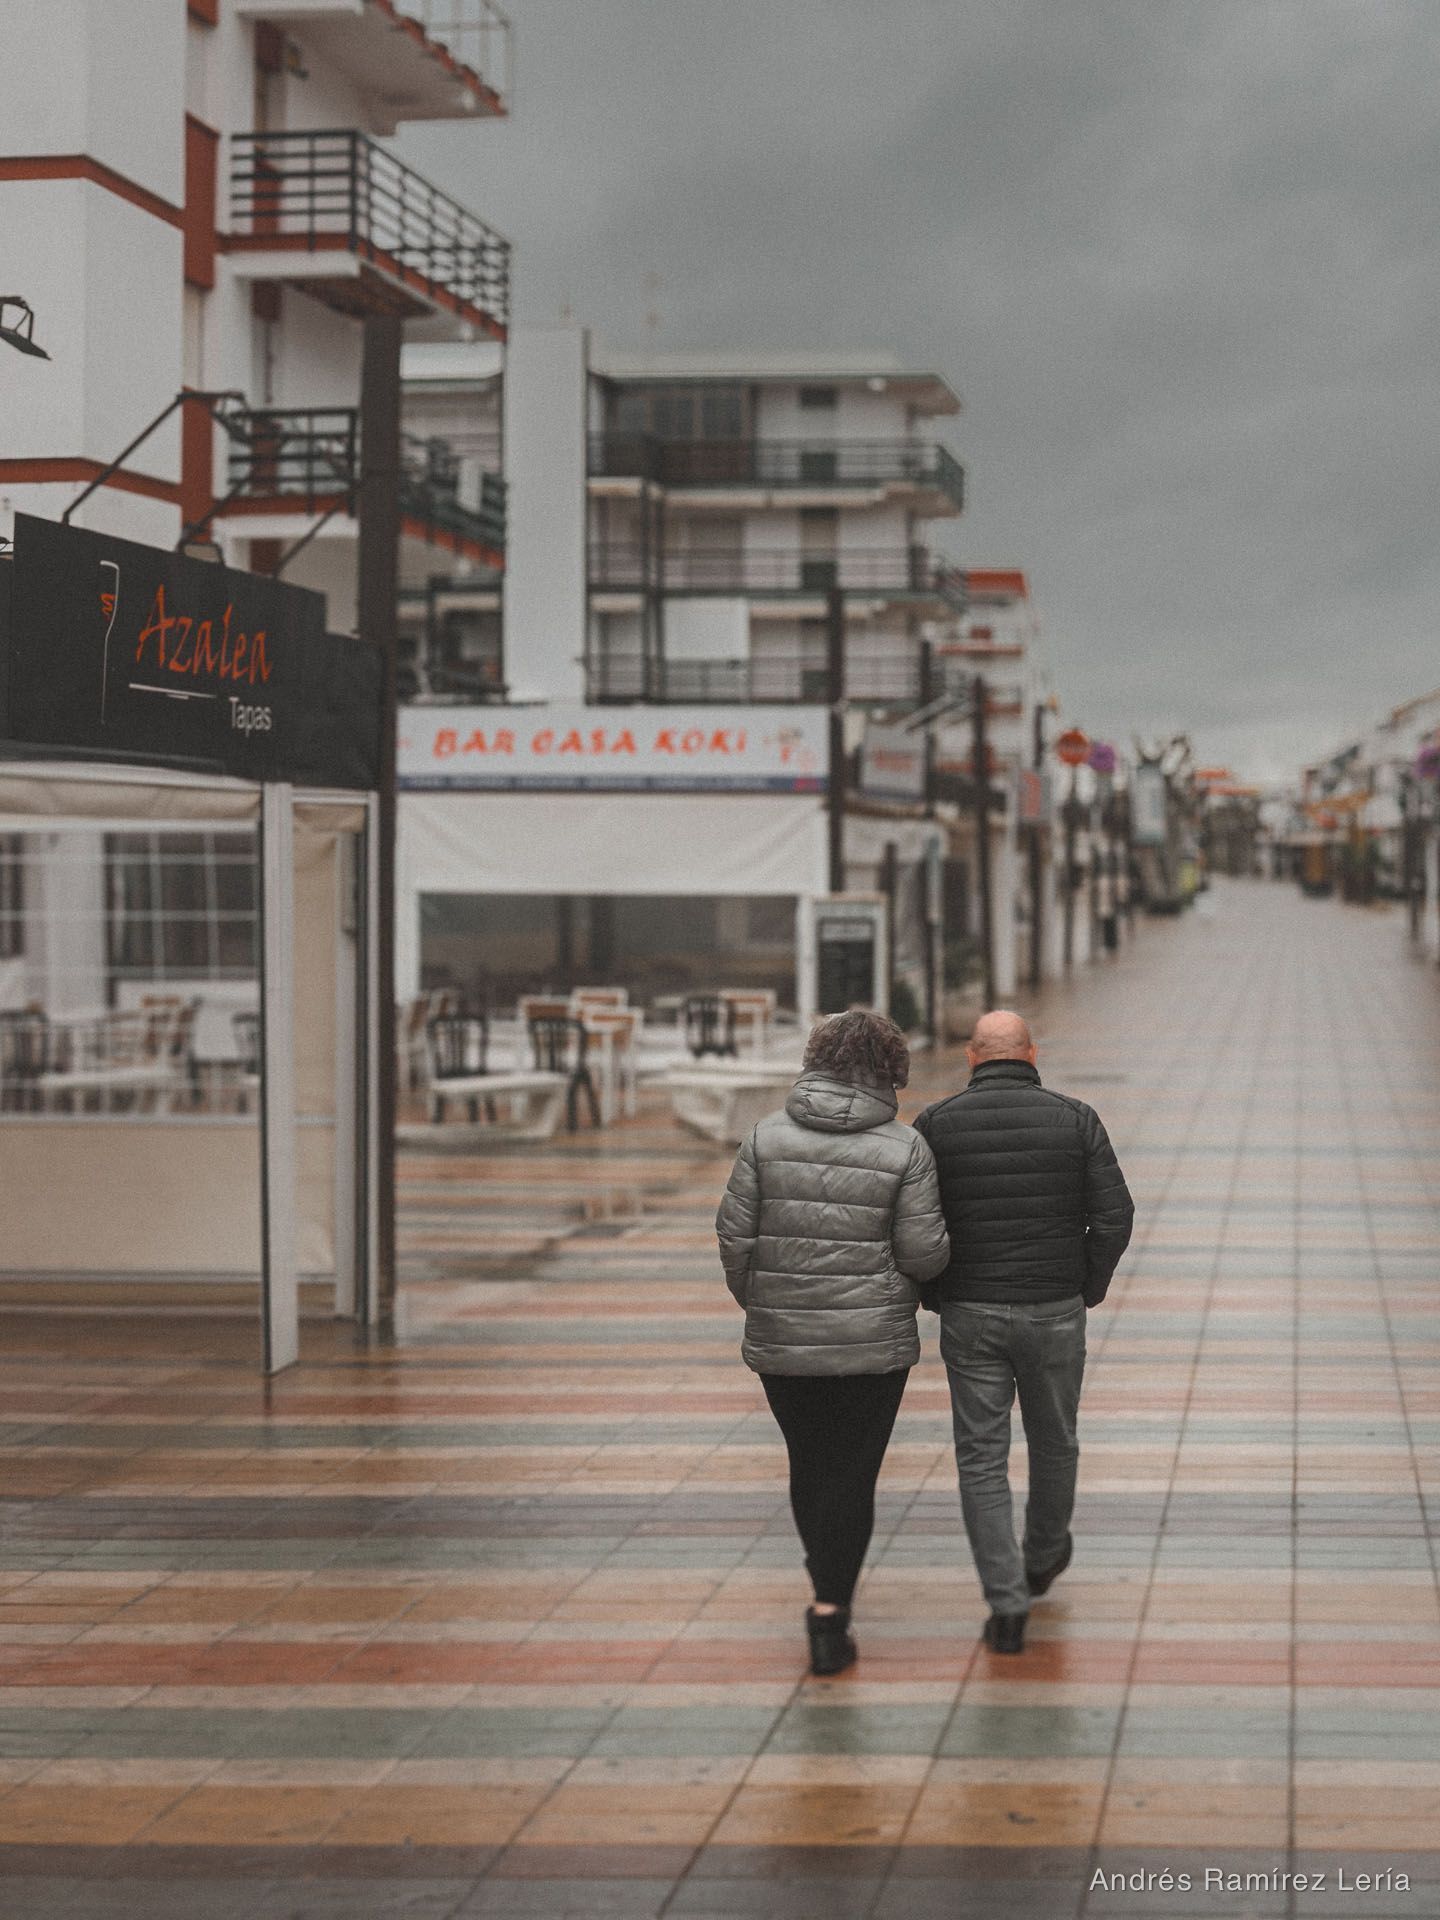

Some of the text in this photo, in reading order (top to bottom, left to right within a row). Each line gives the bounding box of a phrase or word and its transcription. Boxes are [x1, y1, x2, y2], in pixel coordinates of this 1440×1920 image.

[136, 583, 273, 684] Azalea
[229, 697, 272, 737] Tapas
[433, 726, 748, 758] BAR CASA KOKI
